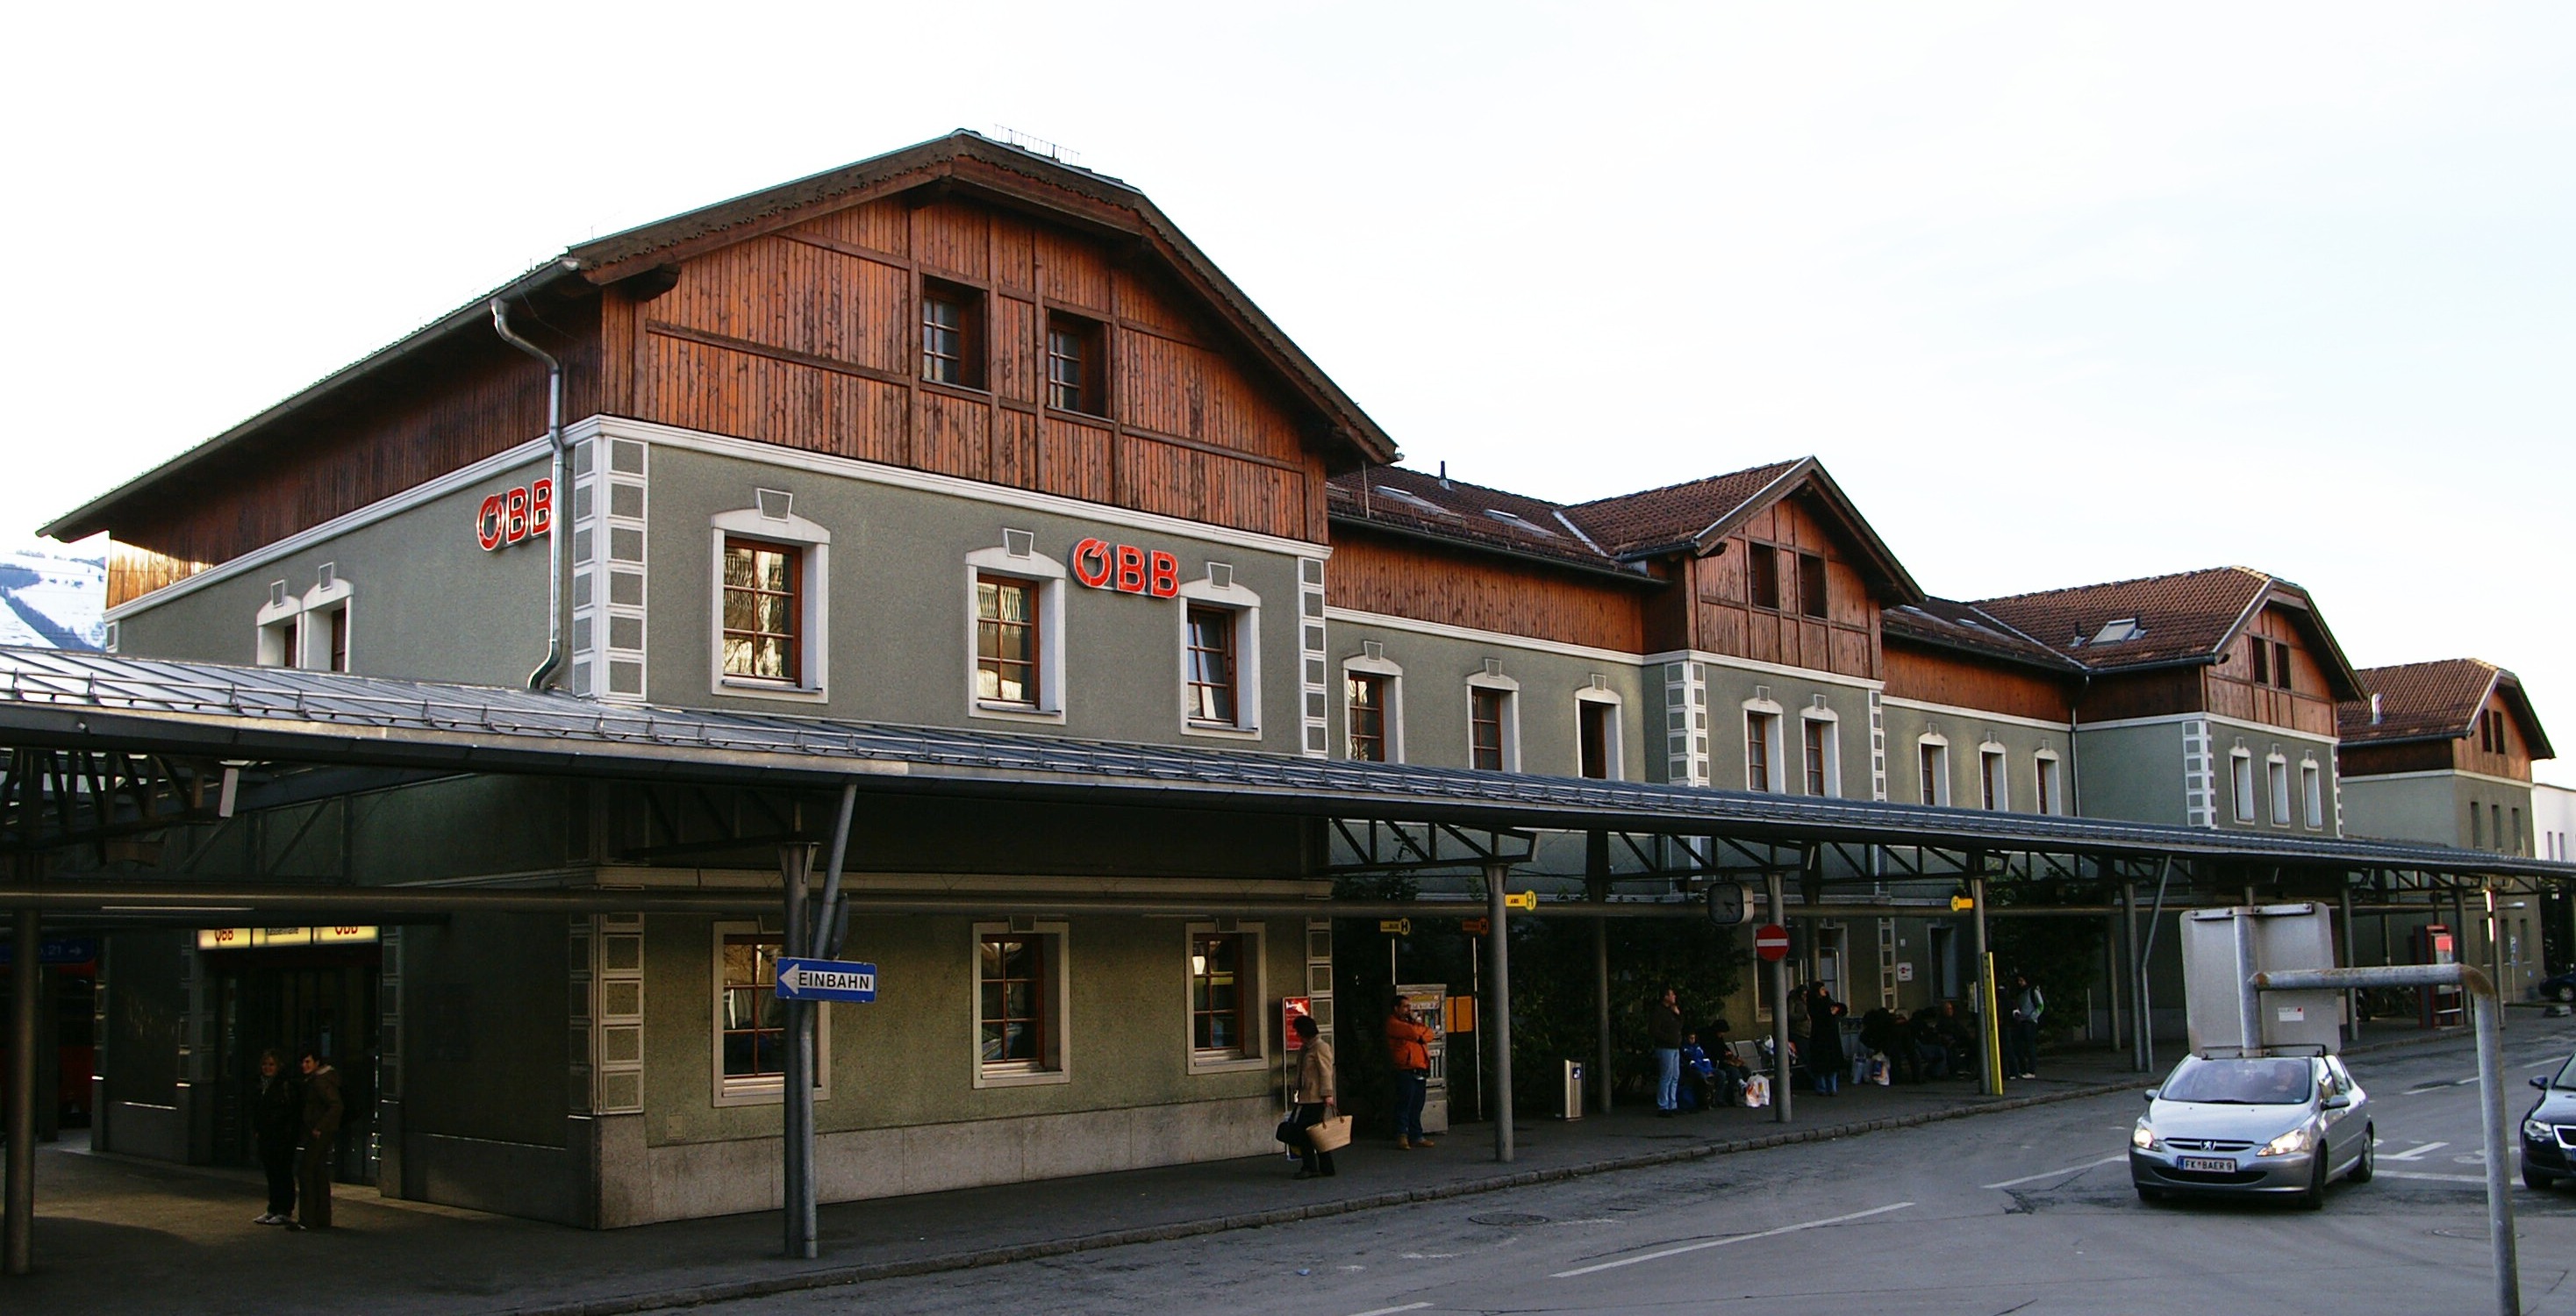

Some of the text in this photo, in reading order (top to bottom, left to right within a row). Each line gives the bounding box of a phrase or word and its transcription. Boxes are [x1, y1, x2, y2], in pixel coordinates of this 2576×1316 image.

[476, 478, 553, 551] ÖBB
[1072, 538, 1179, 598] ÖBB
[798, 971, 869, 990] EINBAHN
